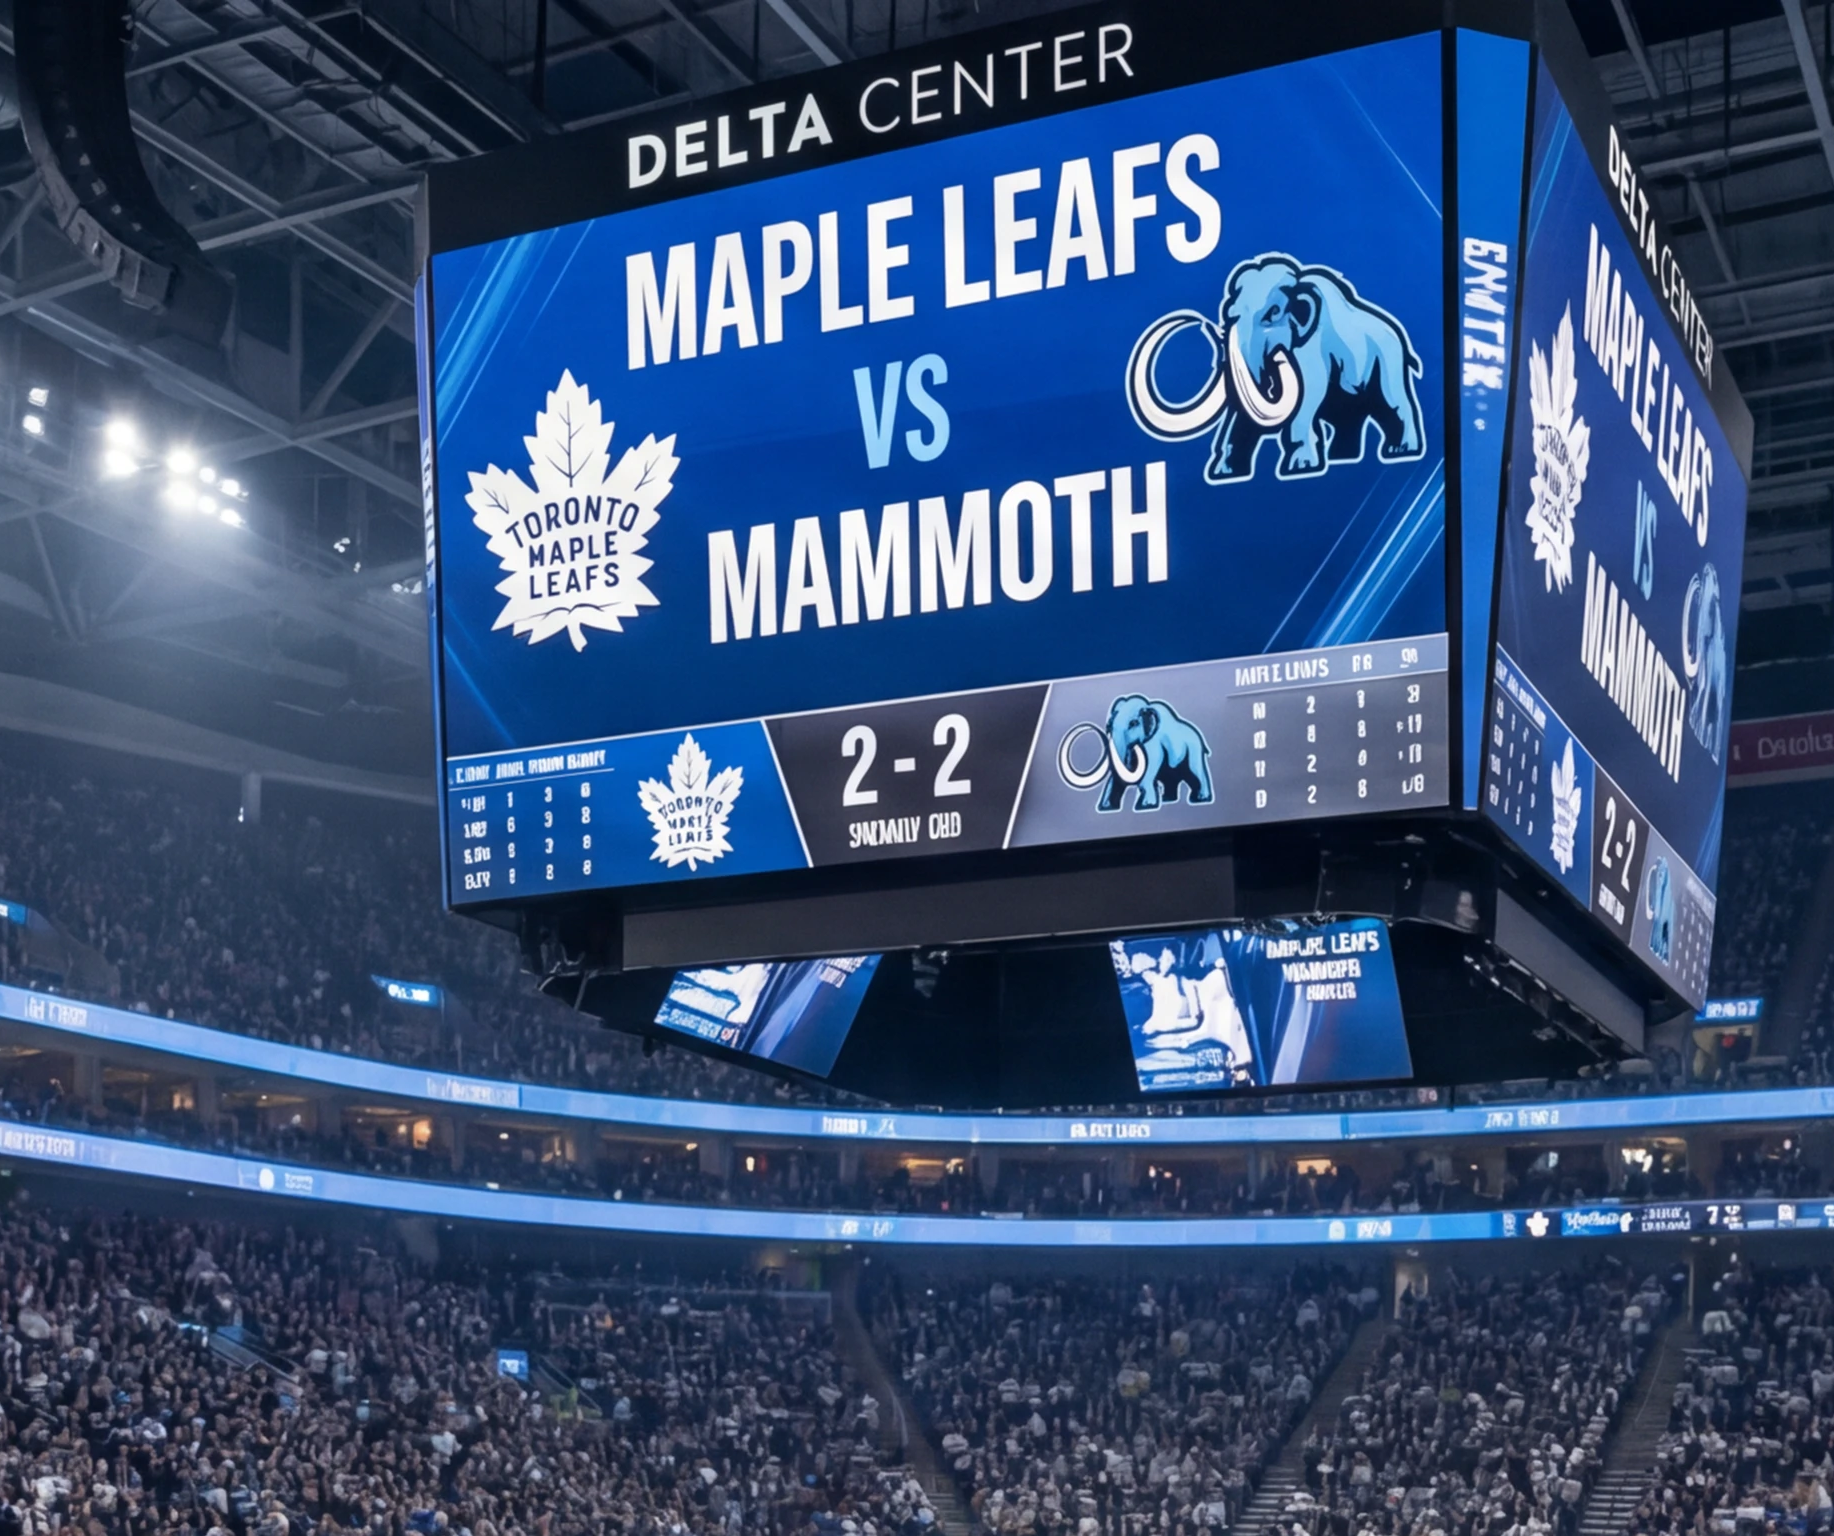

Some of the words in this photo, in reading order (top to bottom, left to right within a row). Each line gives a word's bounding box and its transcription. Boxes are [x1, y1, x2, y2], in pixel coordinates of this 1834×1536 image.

[628, 92, 834, 190] DELTA
[858, 22, 1134, 134] CENTER
[625, 195, 916, 371] MAPLE
[943, 133, 1221, 310] LEAFS
[1608, 124, 1658, 277] DELTA
[1660, 244, 1714, 391] CENTER
[854, 352, 952, 470] VS
[1584, 222, 1661, 453] MAPLE
[1656, 363, 1714, 548] LEAFS
[505, 495, 640, 549] TORONTO
[528, 530, 619, 568] MAPLE
[529, 562, 620, 600] LEAFS
[707, 460, 1169, 645] MAMMOTH
[1632, 479, 1657, 601] VS
[1580, 550, 1687, 784] MAMMOTH
[841, 724, 879, 807] 2
[932, 713, 972, 798] 2
[1600, 796, 1617, 870] 2
[1621, 817, 1637, 893] 2
